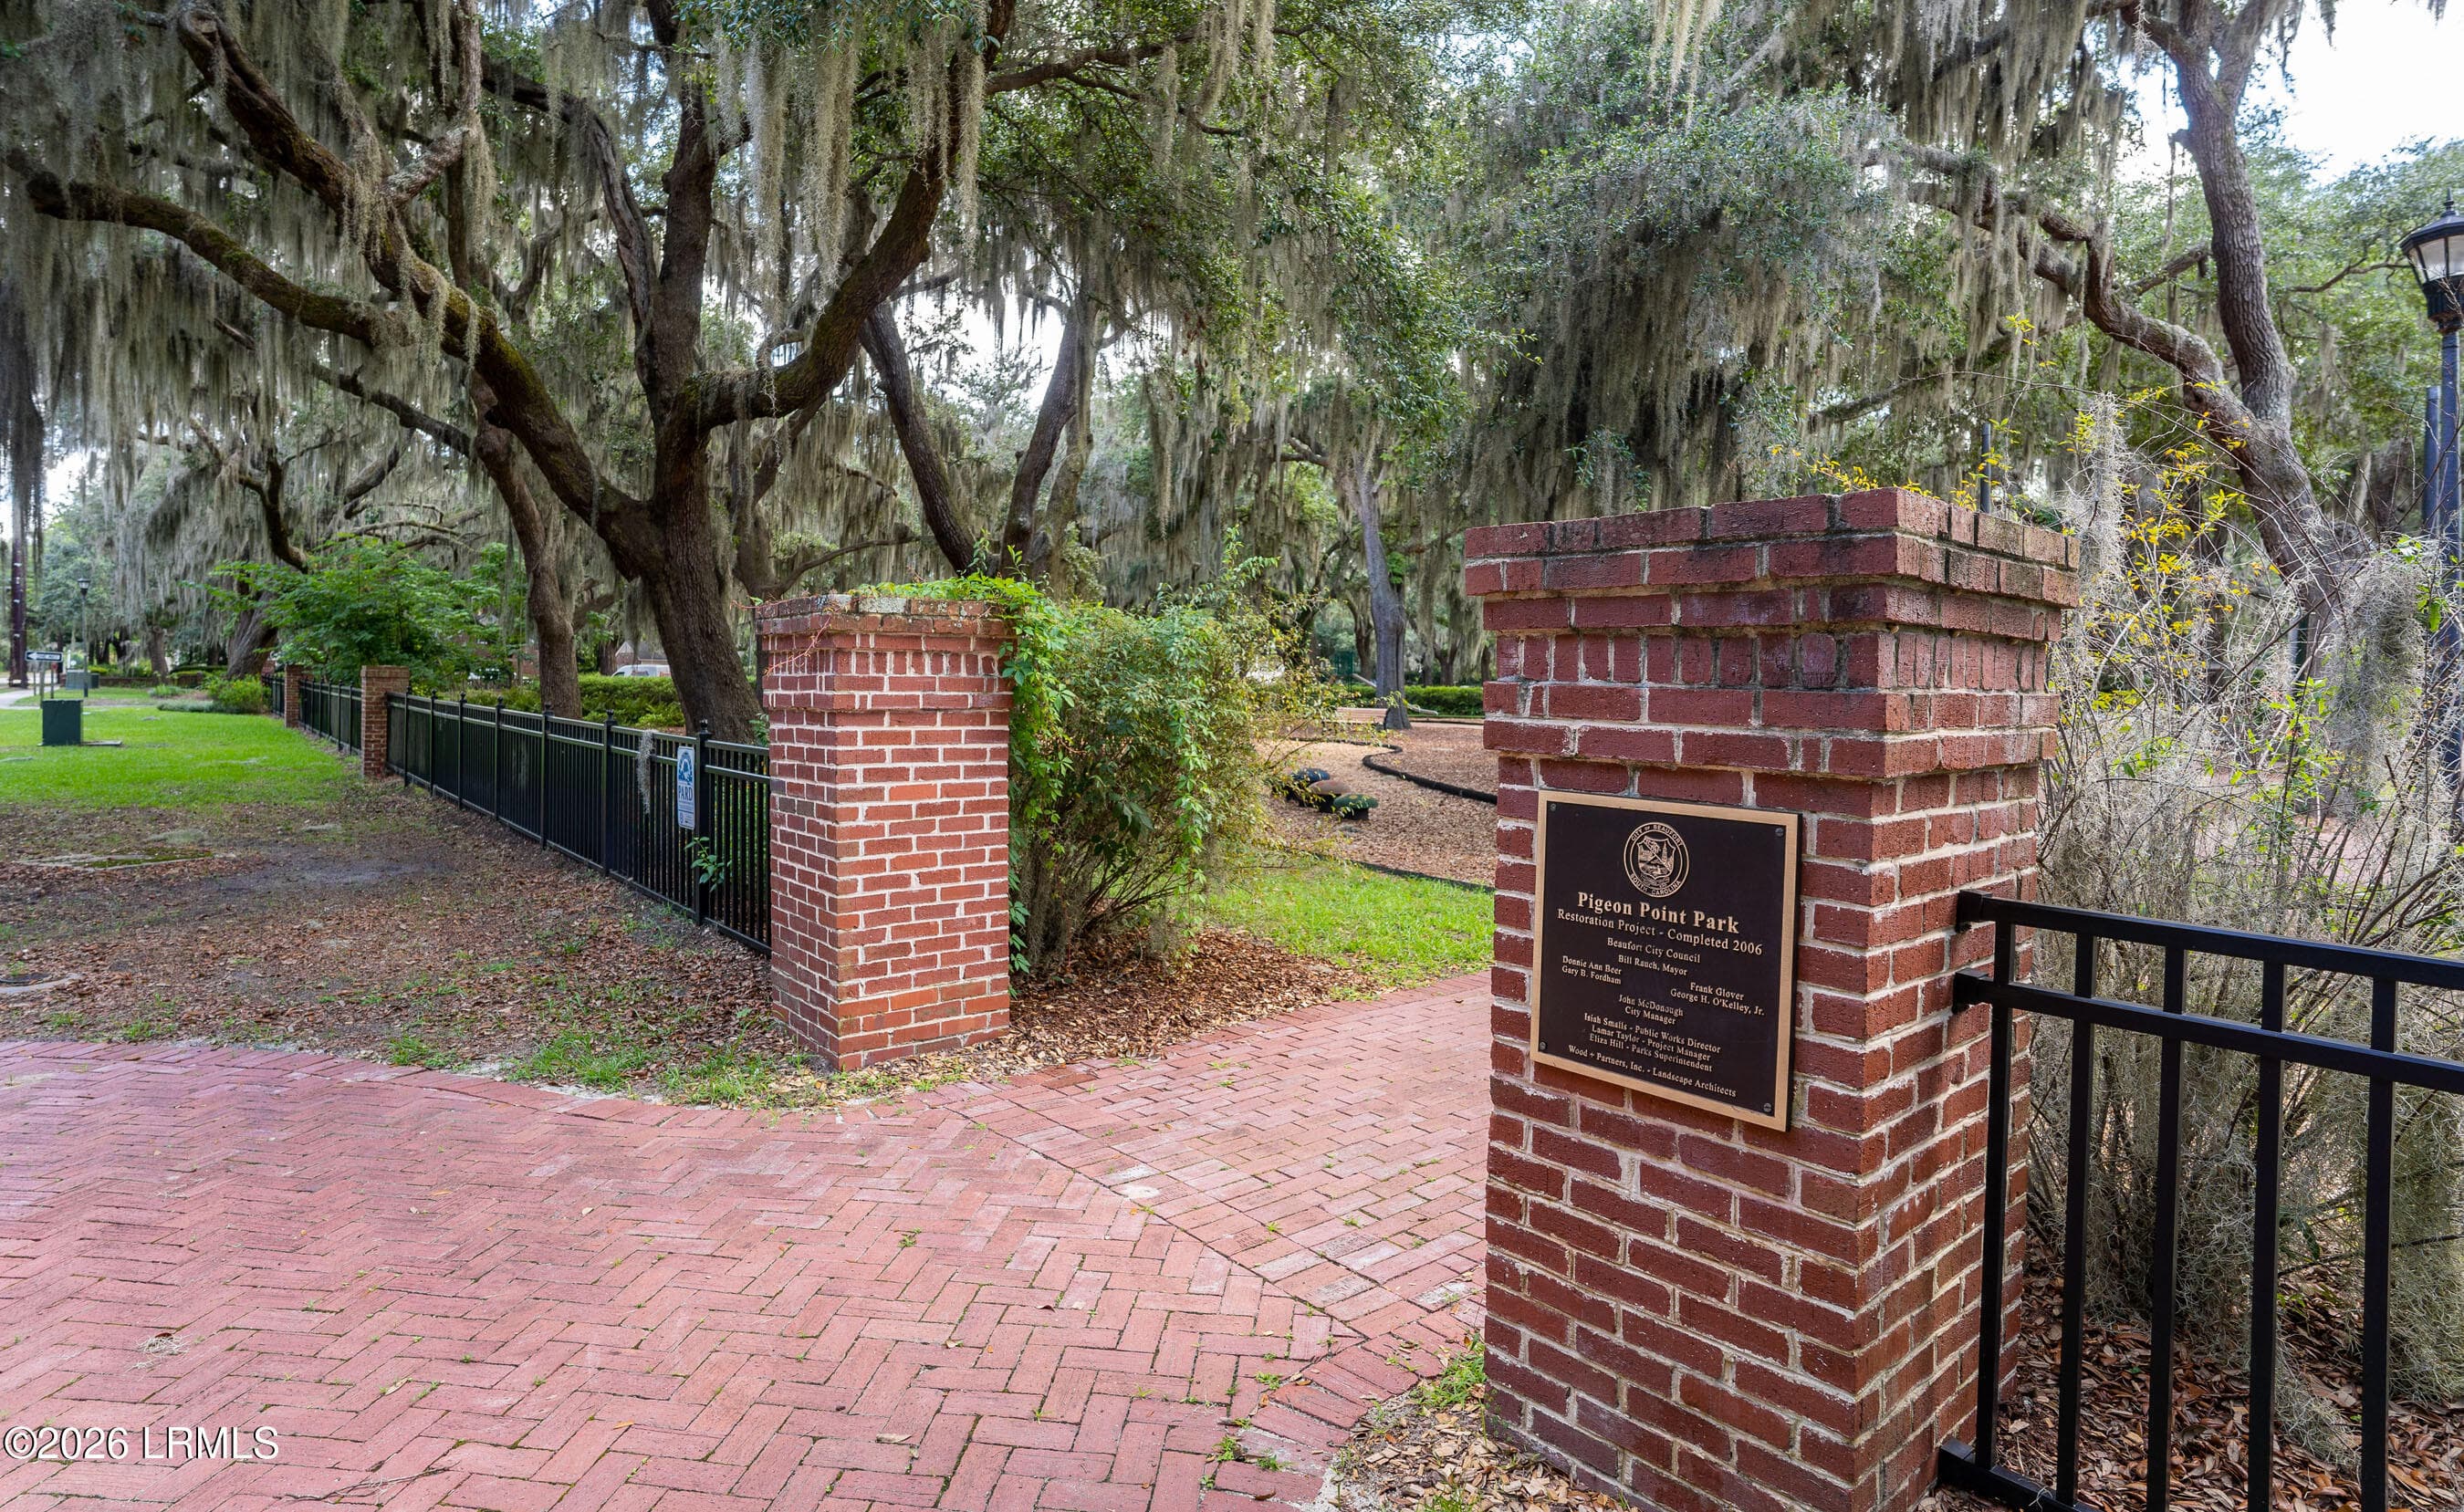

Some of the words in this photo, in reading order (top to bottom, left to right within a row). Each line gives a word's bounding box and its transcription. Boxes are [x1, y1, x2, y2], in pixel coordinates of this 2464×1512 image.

[1631, 829, 1644, 841] CITY
[1653, 824, 1684, 847] BEAUFORT
[1630, 872, 1649, 892] SOUTH
[1651, 880, 1681, 896] CAROLINA
[1577, 891, 1633, 915] Pigeon
[1639, 901, 1687, 925] Point
[1693, 909, 1740, 934] Park
[1557, 908, 1615, 929] Restoration
[1618, 919, 1656, 936] Project
[1667, 927, 1729, 950] Completed
[1732, 939, 1764, 956] 2006
[1607, 936, 1643, 953] Beaufort
[1645, 944, 1664, 958] City
[1665, 948, 1701, 964] Council
[1561, 965, 1579, 977] Gary
[1580, 968, 1589, 978] B.
[1591, 971, 1622, 985] Fordham
[1562, 954, 1587, 967] Donnie
[1588, 961, 1603, 972] Ann
[1604, 964, 1623, 975] Beer
[1618, 954, 1633, 965] Bill
[1662, 963, 1688, 976] Mayor
[1670, 987, 1698, 1003] George
[1700, 995, 1710, 1005] H.
[1712, 996, 1751, 1015] O'Kelley,
[1753, 1005, 1765, 1016] Jr.
[1690, 981, 1714, 996] Frank
[1716, 986, 1745, 1001] Glover
[1618, 994, 1635, 1006] John
[1637, 997, 1684, 1017] McDonough
[1624, 1006, 1642, 1018] City
[1643, 1009, 1676, 1025] Manager
[1584, 1012, 1602, 1024] Isiah
[1603, 1017, 1628, 1031] Smalls
[1634, 1025, 1659, 1038] Public
[1661, 1030, 1686, 1045] Works
[1686, 1038, 1722, 1054] Director
[1592, 1024, 1614, 1038] Lamar
[1615, 1030, 1641, 1044] Taylor
[1647, 1038, 1675, 1053] Project
[1676, 1046, 1712, 1061] Manager
[1590, 1033, 1608, 1045] Eliza
[1609, 1038, 1624, 1049] Hill
[1631, 1044, 1653, 1058] Parks
[1654, 1050, 1714, 1073] Superintendent
[1568, 1044, 1589, 1058] Wood
[1596, 1052, 1629, 1069] Partners,
[1630, 1061, 1645, 1073] Inc.
[1653, 1067, 1694, 1086] Landscape
[1694, 1079, 1738, 1098] Architects
